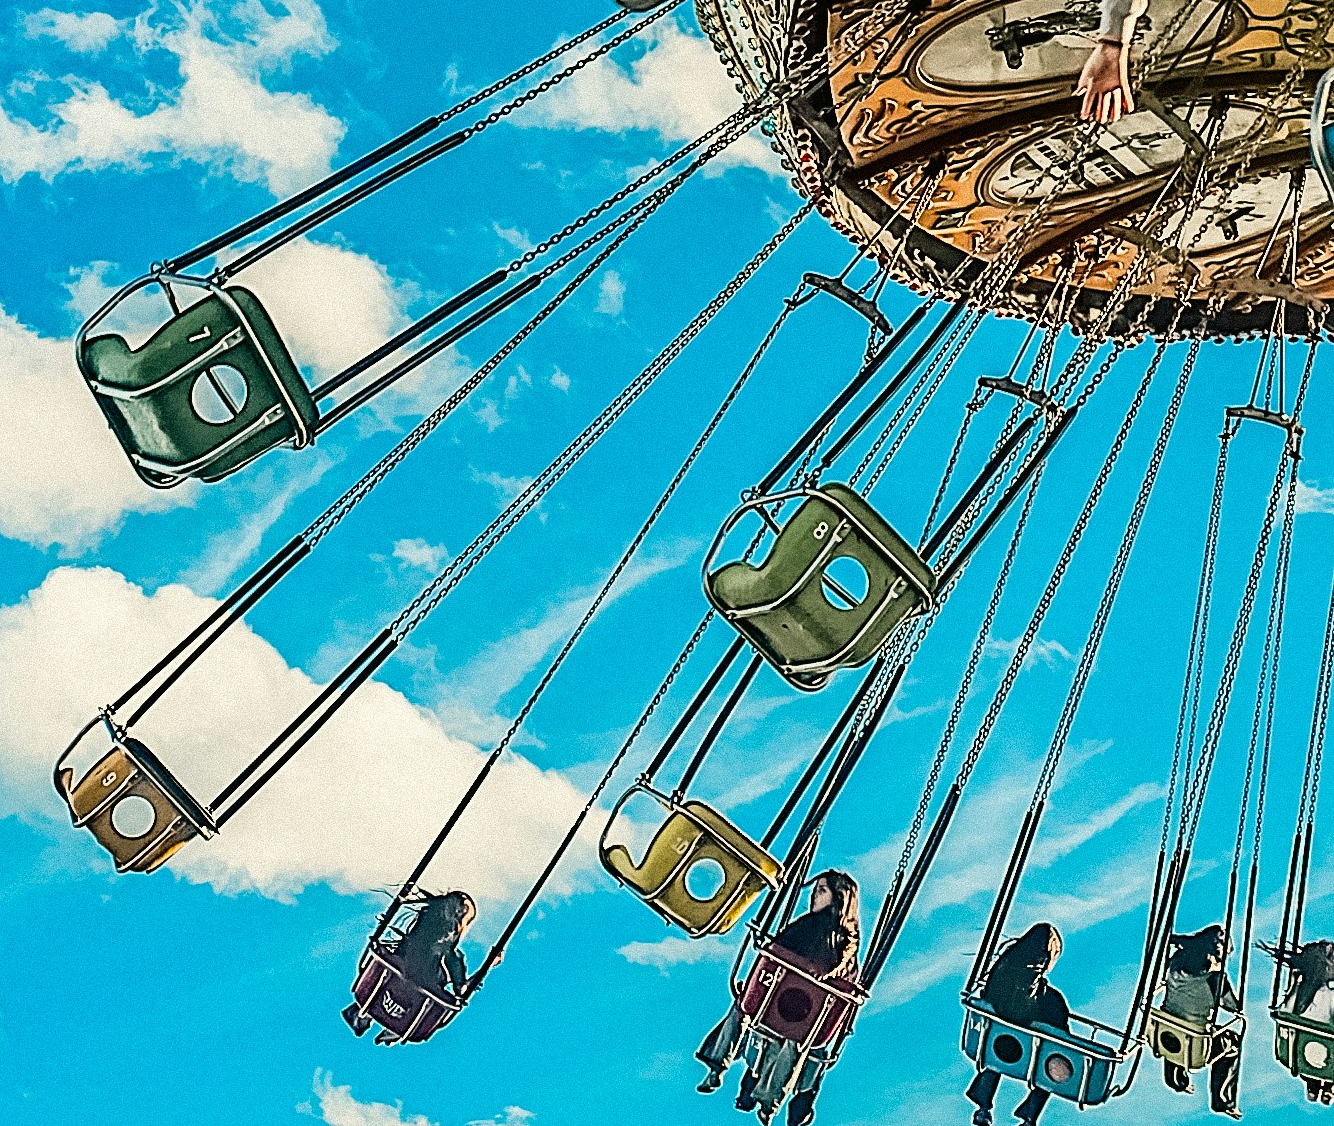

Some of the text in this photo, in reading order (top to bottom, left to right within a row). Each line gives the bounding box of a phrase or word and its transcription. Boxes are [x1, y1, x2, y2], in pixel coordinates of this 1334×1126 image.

[188, 325, 211, 342] 7
[813, 521, 829, 540] 8
[101, 771, 117, 787] 9
[671, 837, 690, 855] 10
[758, 969, 774, 987] 12
